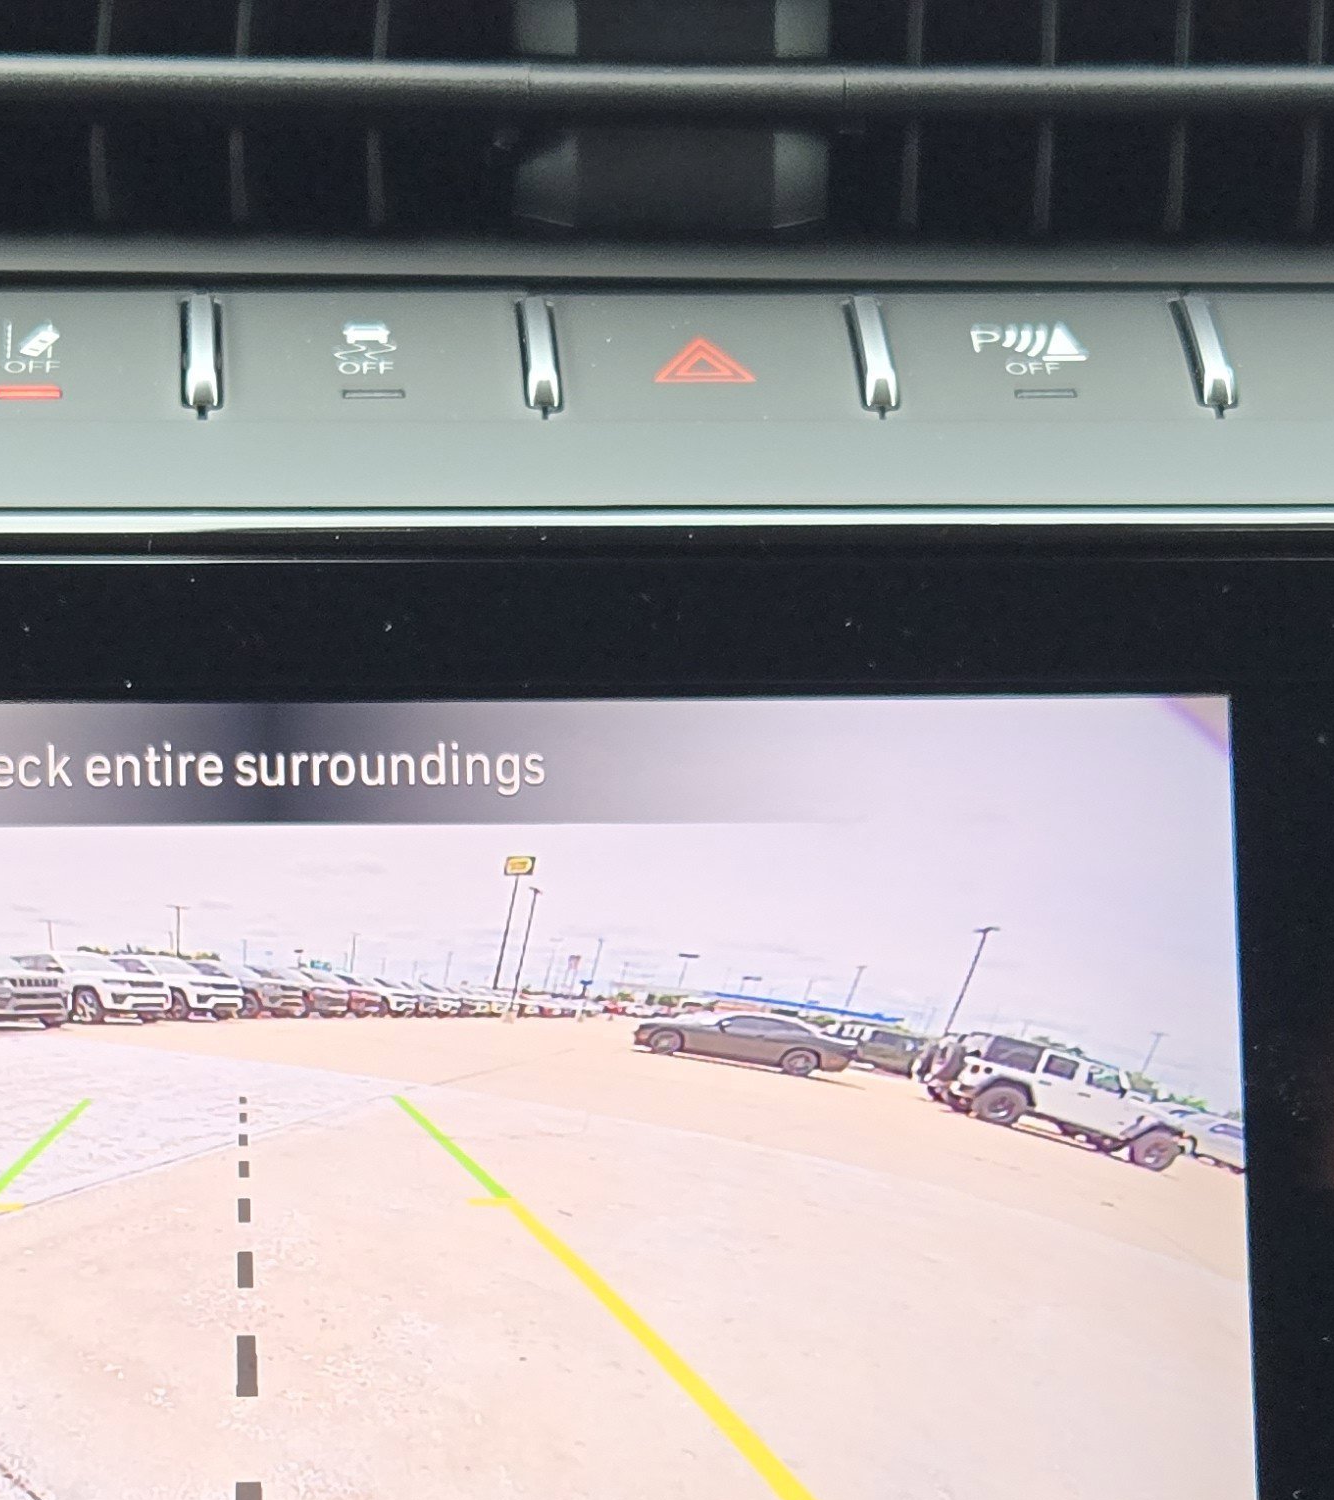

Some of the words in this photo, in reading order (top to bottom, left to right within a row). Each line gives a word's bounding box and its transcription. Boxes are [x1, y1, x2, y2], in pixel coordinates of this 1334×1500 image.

[3, 359, 61, 374] OFF
[338, 360, 394, 375] OFF
[1005, 361, 1061, 376] OFF
[85, 742, 224, 788] entire
[235, 741, 547, 796] surroundings
